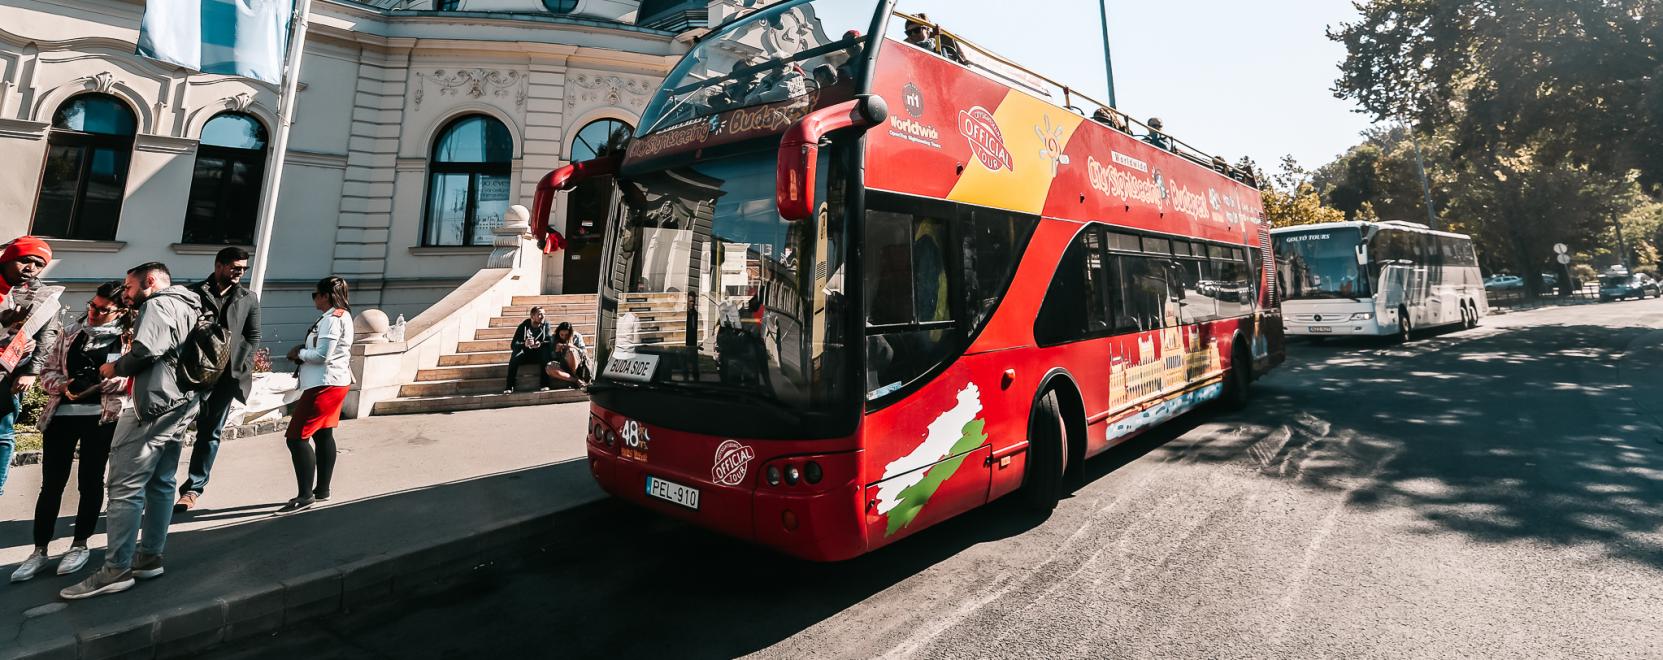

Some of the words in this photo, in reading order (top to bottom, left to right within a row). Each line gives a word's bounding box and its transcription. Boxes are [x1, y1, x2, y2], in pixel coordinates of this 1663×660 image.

[965, 118, 1011, 169] OFFICIAL
[977, 147, 999, 170] TOUR
[1308, 233, 1331, 241] TOURS
[610, 359, 630, 375] BUDA
[630, 360, 650, 377] SIDE
[621, 419, 639, 447] 48
[715, 448, 752, 479] OFFICIAL
[728, 466, 746, 483] TOUR
[652, 479, 696, 507] PEL-910
